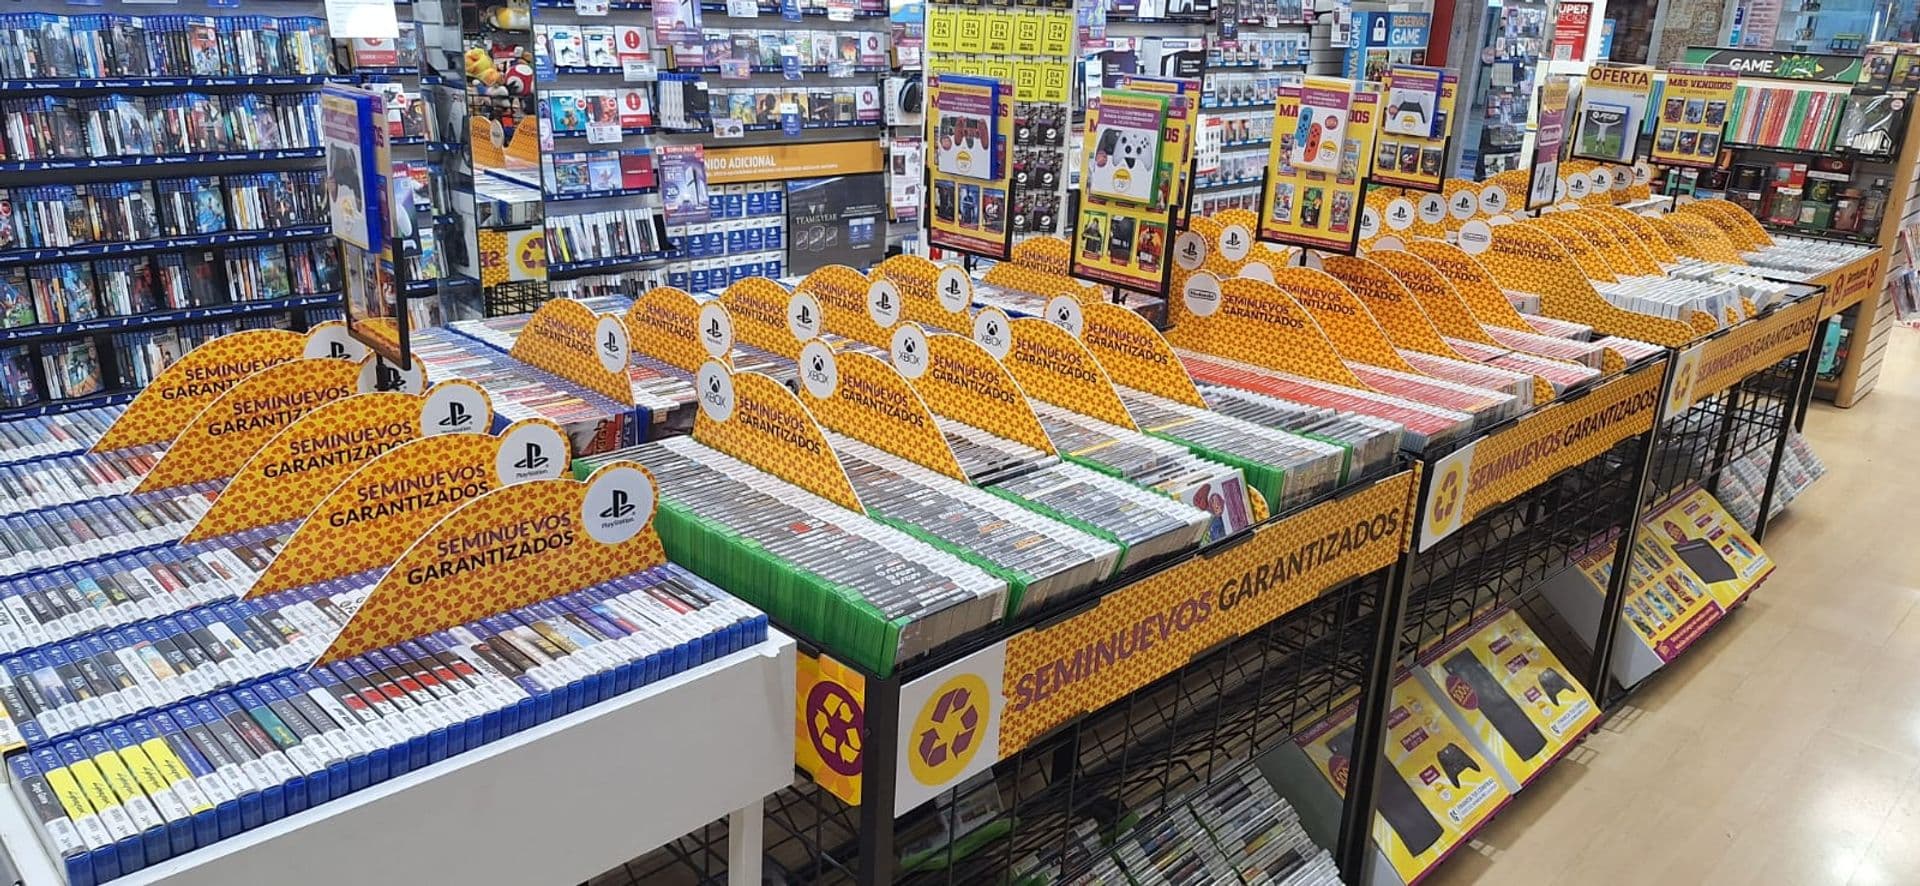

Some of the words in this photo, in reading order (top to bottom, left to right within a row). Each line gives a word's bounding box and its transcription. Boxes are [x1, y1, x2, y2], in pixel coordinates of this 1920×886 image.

[1351, 16, 1362, 49] GAME
[1391, 28, 1420, 44] GAME
[1590, 67, 1649, 86] OFERTA
[1729, 58, 1775, 73] GAME
[728, 154, 777, 169] ADICIONAL
[1331, 271, 1389, 289] EMINUEVOS
[1390, 267, 1432, 283] NUEVOS
[1440, 268, 1481, 283] TIZADOS
[814, 279, 863, 301] SEMINUEVOS
[902, 283, 934, 300] TIZADOS
[1349, 284, 1402, 303] NTIZADOS
[643, 302, 695, 325] SEMINUEVOS
[725, 302, 785, 330] GARANTIZADOS
[735, 293, 785, 316] SEMINUEVOS
[1222, 304, 1304, 329] GARANTIZADOS
[1223, 294, 1289, 315] SEMINUEVOS
[1298, 297, 1356, 316] ANTIZADOS
[543, 315, 592, 339] SEMINUEVOS
[635, 311, 696, 342] GARANTIZADOS
[1087, 322, 1154, 348] SEMINUEVOS
[533, 325, 593, 357] GARANTIZADOS
[980, 333, 1003, 348] XBOX
[1015, 337, 1082, 366] SEMINUEVOS
[1086, 335, 1168, 365] GARANTIZADOS
[185, 356, 295, 381] SEMINUEV
[898, 350, 921, 366] XBOX
[933, 354, 1000, 384] SEMINUEVOS
[1014, 351, 1097, 383] GARANTIZADOS
[162, 378, 241, 400] GARANT
[807, 369, 829, 385] XBOX
[932, 368, 1016, 404] GARANTIZADOS
[232, 385, 350, 416] SEMINUEVOS
[703, 392, 727, 409] XBOX
[841, 374, 909, 407] SEMINUEVOS
[739, 396, 805, 432] SEMINUEVOS
[841, 388, 924, 427] GARANTIZADOS
[207, 407, 314, 437] GARANTIZ
[738, 412, 821, 455] GARANTIZADOS
[289, 420, 412, 456] SEMINUEVOS
[1467, 426, 1563, 495] SEMINUEVOS
[1562, 383, 1658, 447] GARANTIZADOS
[263, 437, 414, 478] GARANTIZAD
[356, 463, 486, 503] SEMINUEVOS
[329, 479, 489, 528] GARANTIZADOS
[436, 511, 571, 559] SEMINUEVOS
[600, 516, 634, 530] PlayStation
[406, 530, 575, 586] GARANTIZADOS
[1013, 590, 1212, 713] SEMINUEVOS
[1218, 506, 1400, 611] GARANTIZADOS
